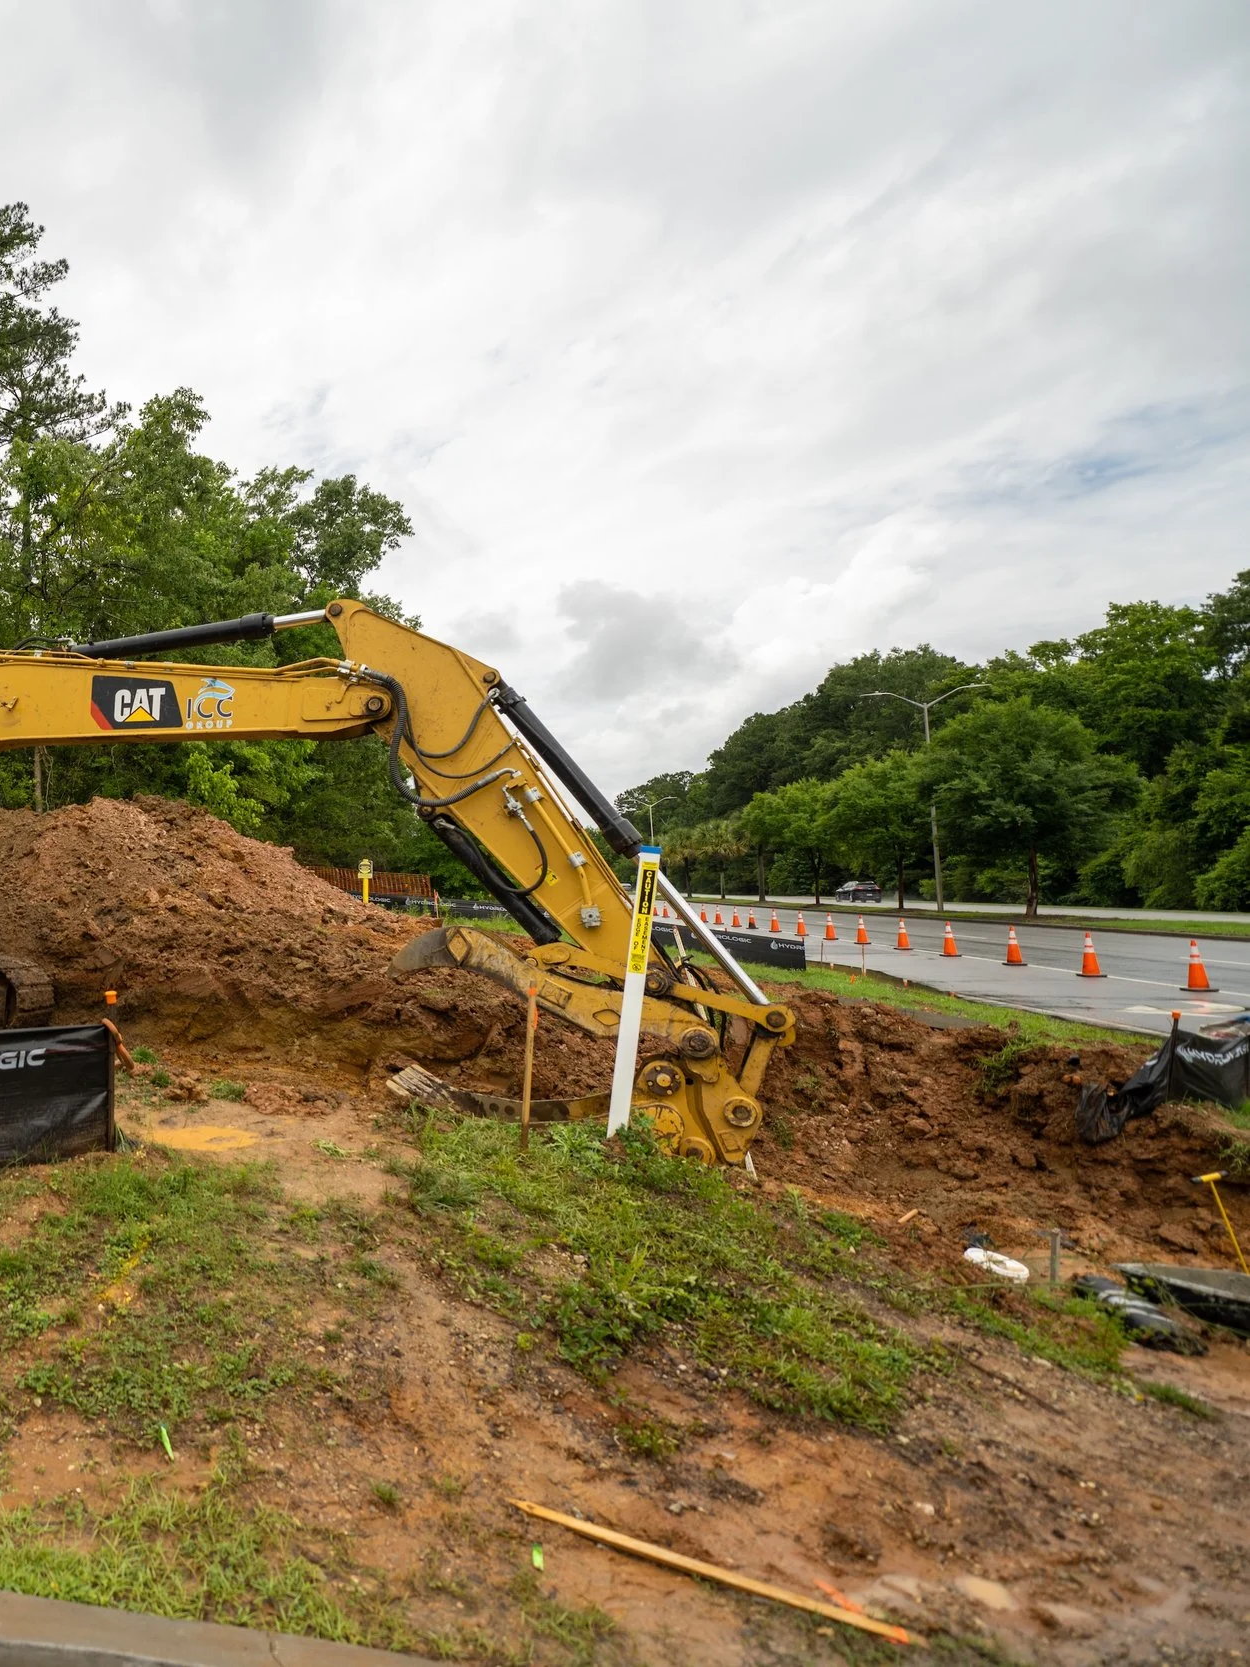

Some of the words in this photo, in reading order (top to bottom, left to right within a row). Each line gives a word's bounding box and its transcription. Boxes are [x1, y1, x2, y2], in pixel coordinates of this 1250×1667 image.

[113, 687, 166, 723] CAT
[186, 696, 234, 719] ICC
[641, 870, 654, 914] CAUTION
